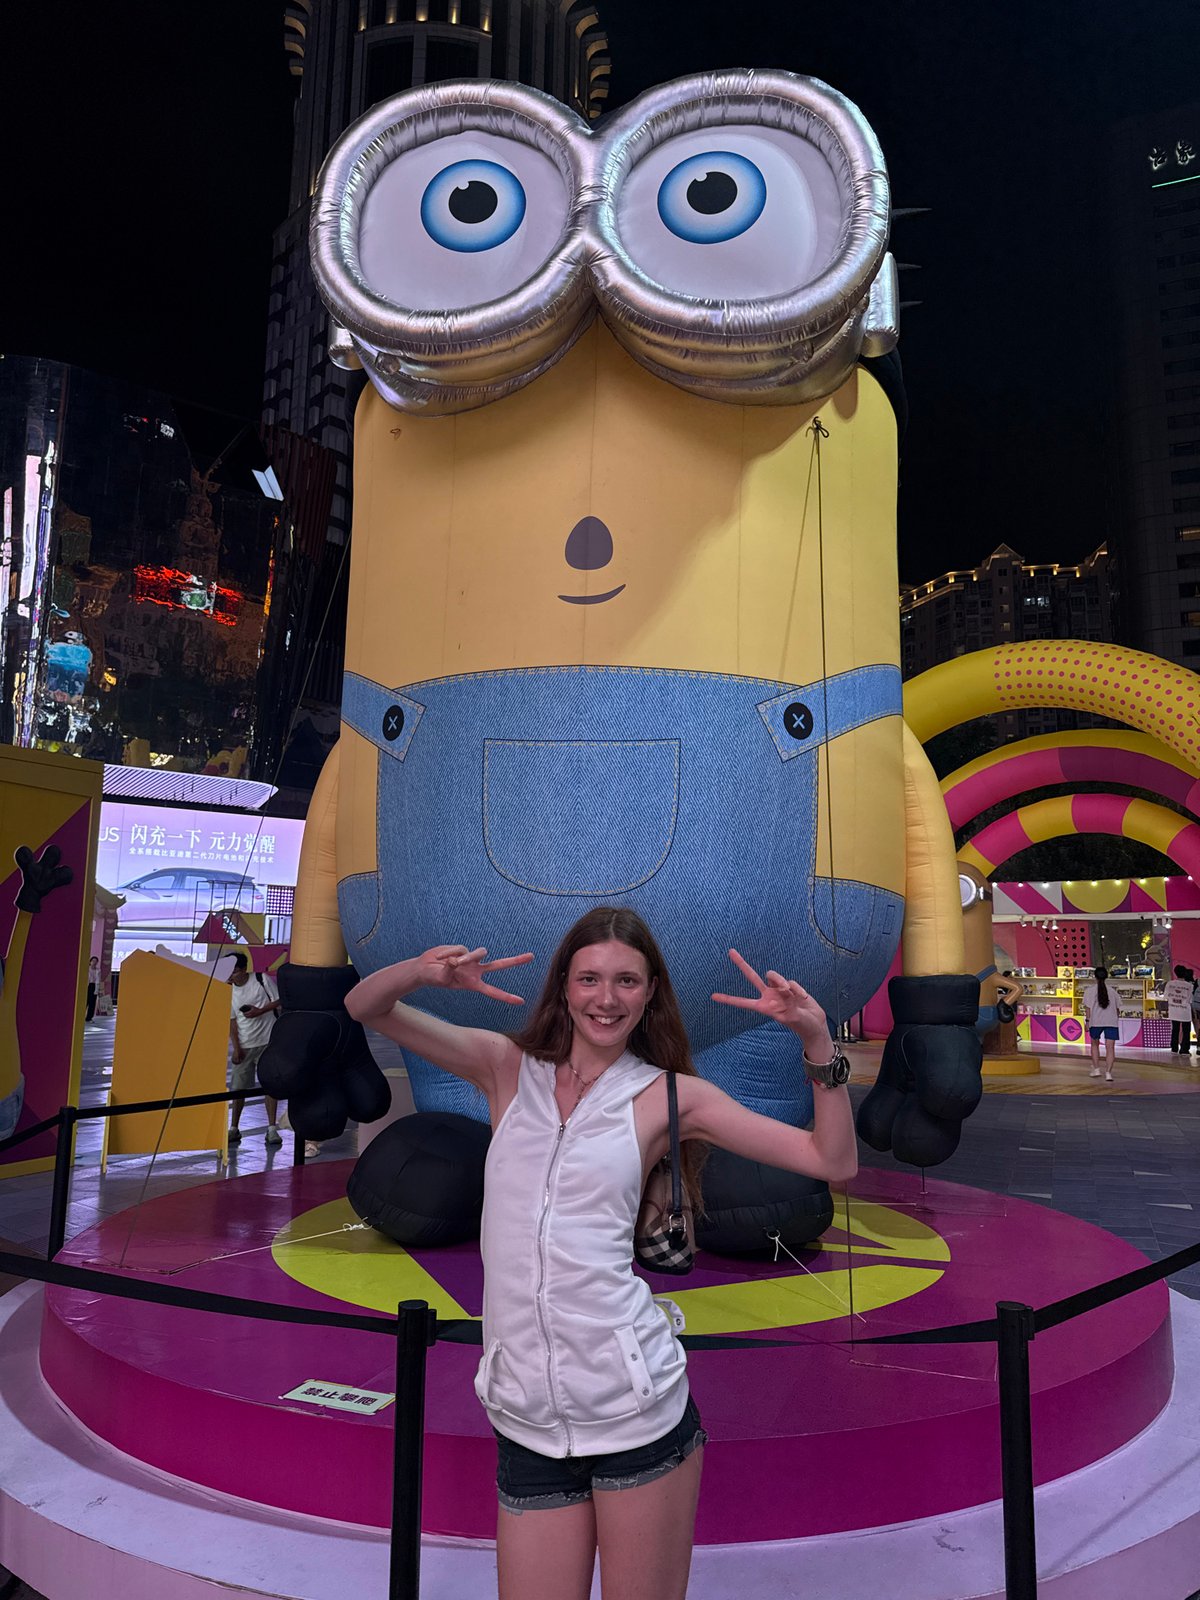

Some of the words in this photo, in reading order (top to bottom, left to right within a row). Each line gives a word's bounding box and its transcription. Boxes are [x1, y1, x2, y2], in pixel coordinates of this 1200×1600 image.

[130, 823, 202, 849] 闪充一下
[209, 831, 276, 854] 元力觉醒
[301, 1387, 378, 1406] 禁止攀爬
